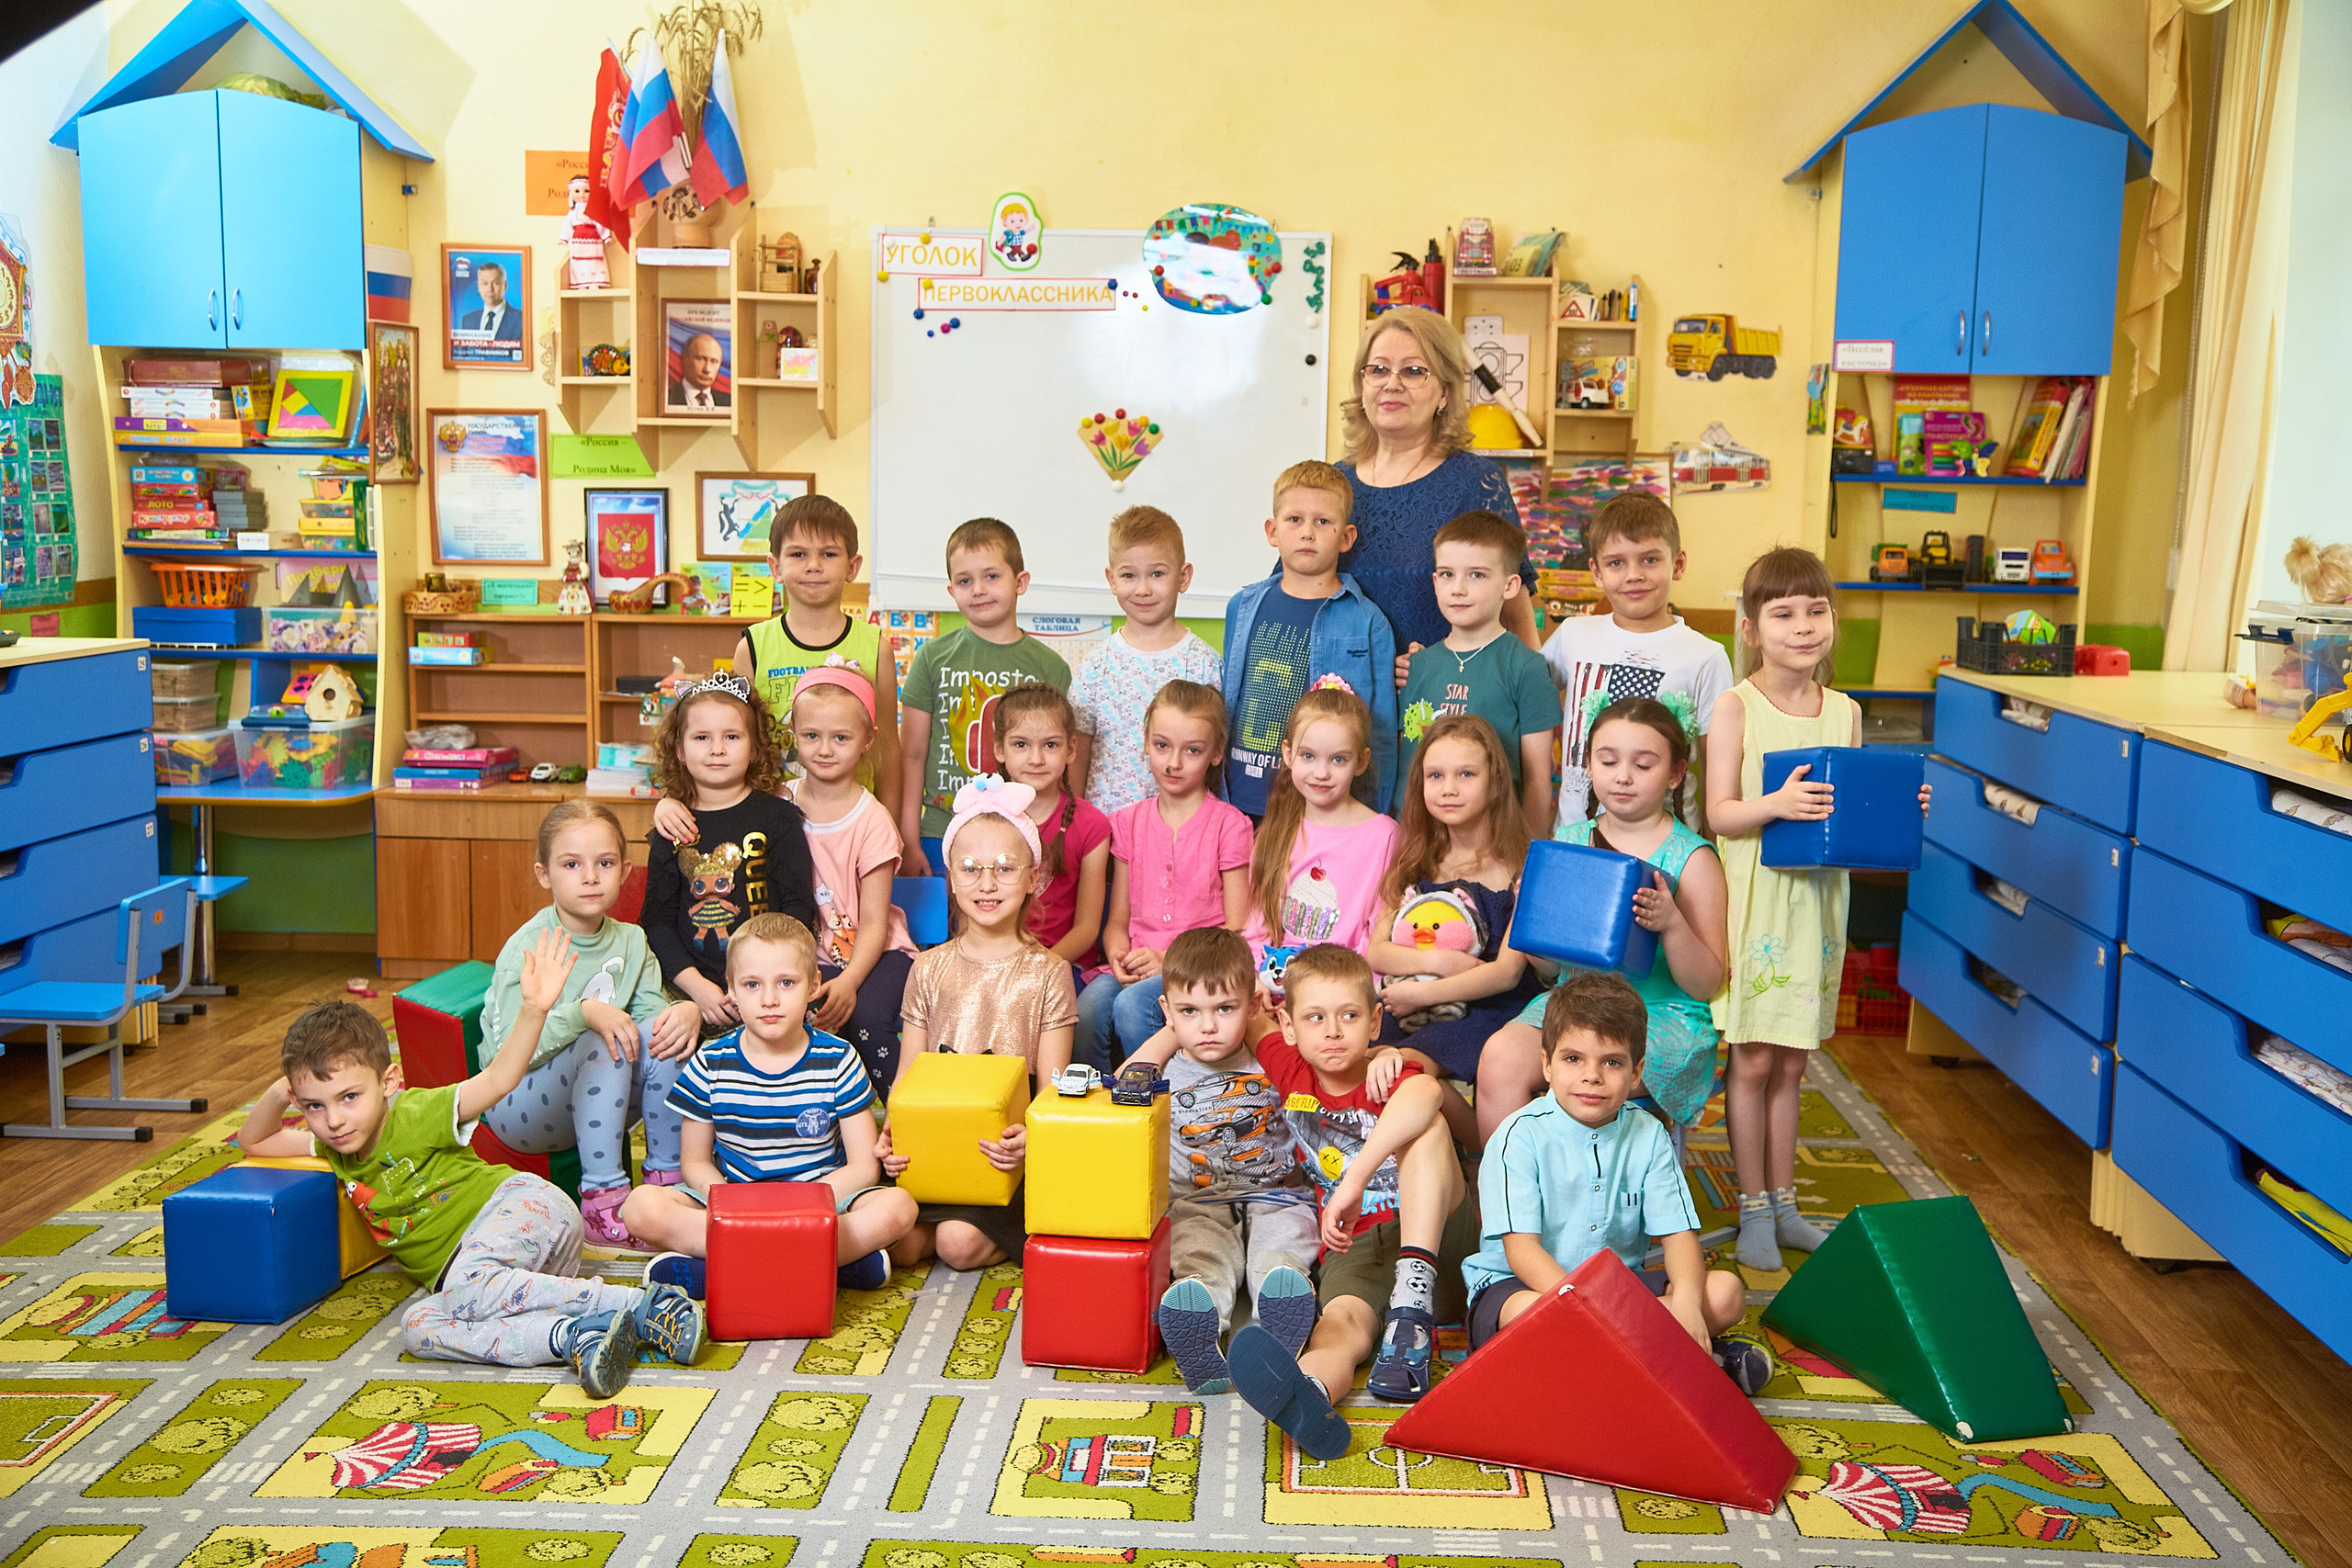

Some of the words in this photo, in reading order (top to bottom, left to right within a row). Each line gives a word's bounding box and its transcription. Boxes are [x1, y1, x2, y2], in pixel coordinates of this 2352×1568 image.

[886, 244, 978, 266] УГОЛОК
[922, 286, 1114, 302] ПЕРВОКЛАССНИКА
[581, 436, 619, 446] «Россия
[573, 464, 607, 474] Родина
[148, 501, 174, 509] ЛОТО
[868, 611, 880, 626] А
[890, 613, 902, 626] Б
[914, 613, 927, 627] В
[1445, 683, 1469, 701] STAR
[1440, 702, 1467, 716] STYLE
[1258, 753, 1271, 768] OF
[1300, 1097, 1319, 1110] FLIP
[1319, 1107, 1346, 1122] CITY
